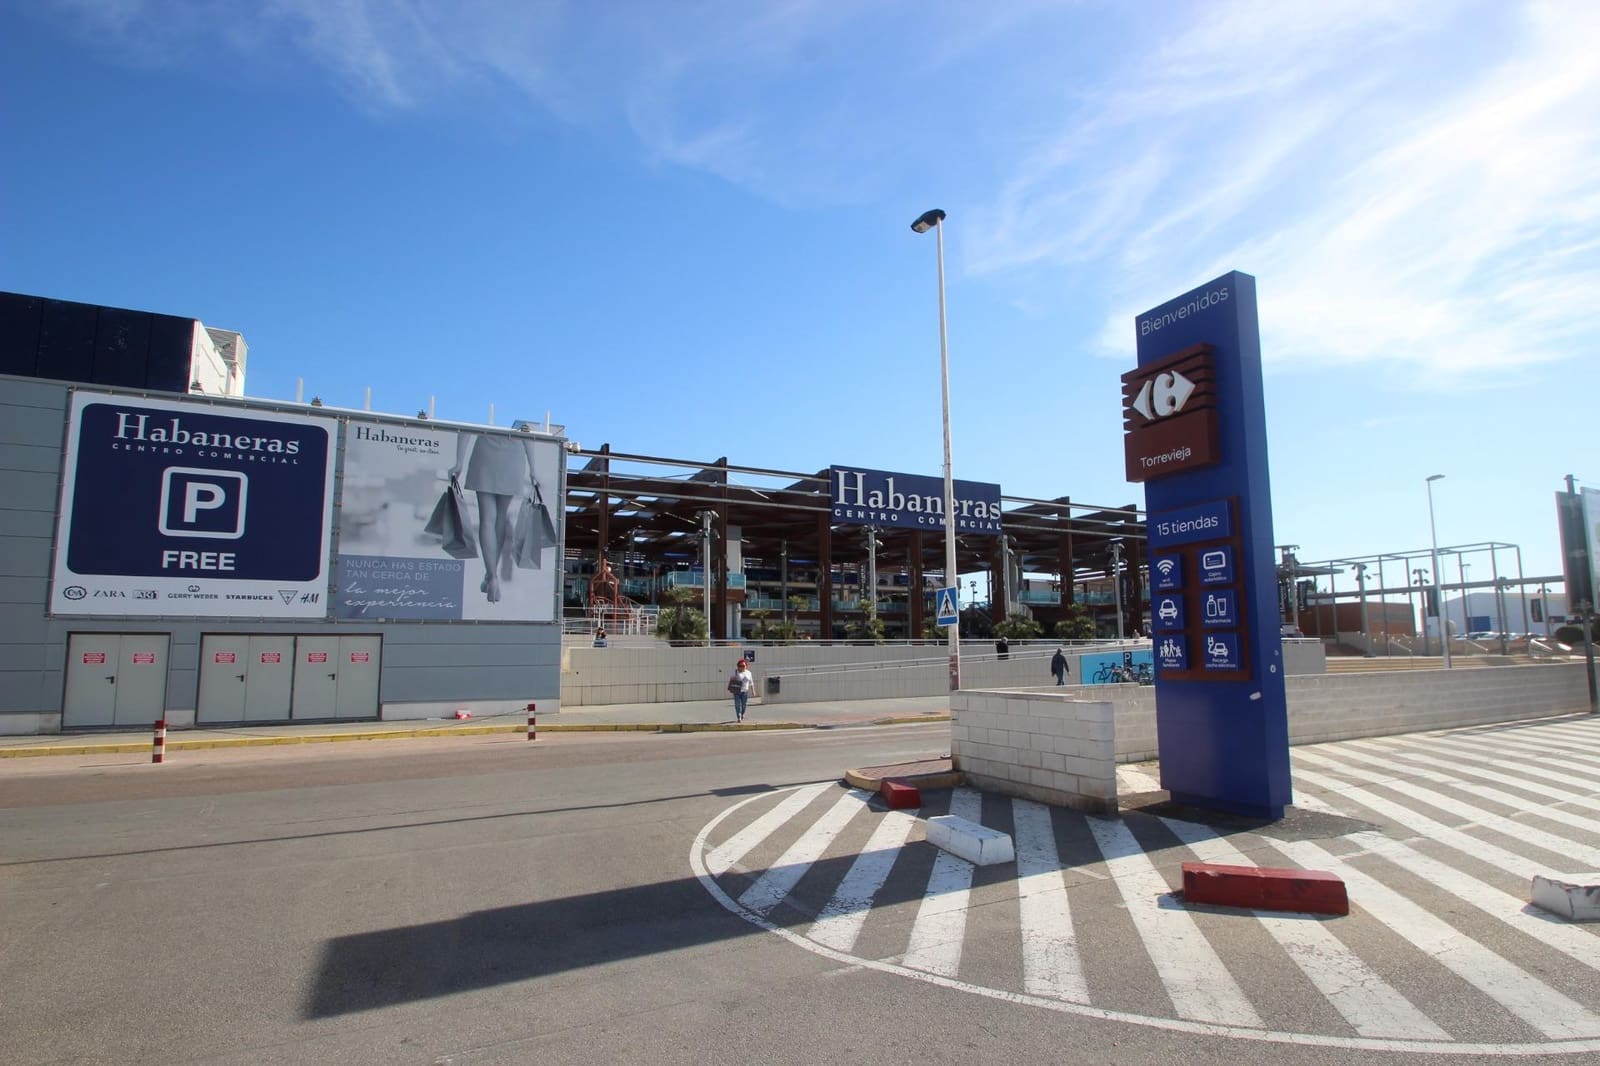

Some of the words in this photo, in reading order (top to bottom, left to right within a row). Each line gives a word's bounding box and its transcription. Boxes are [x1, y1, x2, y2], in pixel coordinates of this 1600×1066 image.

[1141, 287, 1229, 336] Bienvenidos
[113, 412, 300, 455] Habaneras
[356, 426, 440, 447] Habaneras
[112, 442, 183, 455] CENTRO
[198, 450, 299, 464] COMERCIAL
[1140, 446, 1191, 468] Torrevieja
[184, 482, 226, 523] P
[834, 508, 898, 521] CENTRO
[918, 516, 1001, 530] COMRCIAL
[1157, 523, 1169, 536] 15
[1171, 515, 1218, 534] tiendas
[162, 550, 236, 571] FREE
[346, 560, 387, 569] NUNCA
[392, 561, 414, 570] HAS
[419, 562, 461, 572] ESTADO
[346, 569, 367, 578] TAN
[372, 570, 411, 580] CERCA
[415, 572, 430, 581] DE
[93, 589, 126, 598] ZARA
[167, 592, 191, 600] GERRY
[373, 584, 429, 602] mejor
[344, 596, 457, 614] experiencia
